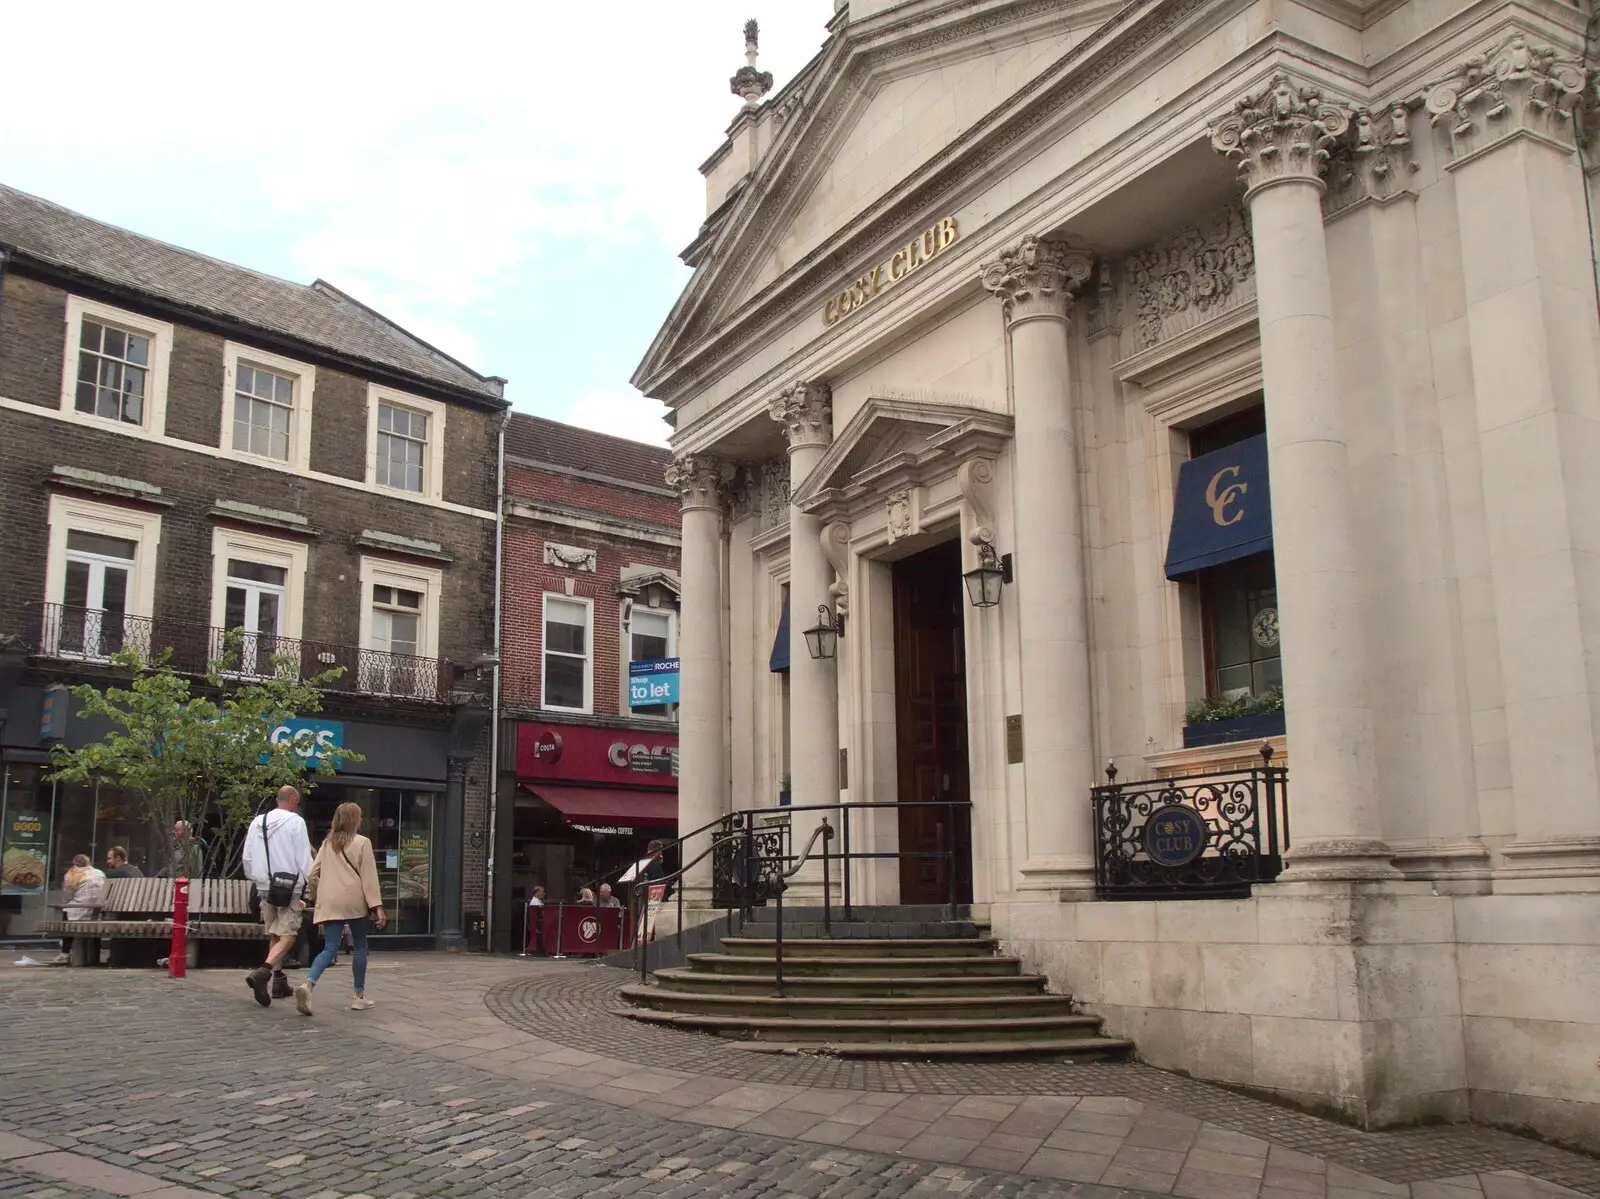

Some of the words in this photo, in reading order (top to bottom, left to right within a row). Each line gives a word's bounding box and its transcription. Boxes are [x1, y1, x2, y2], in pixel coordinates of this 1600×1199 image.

[822, 265, 884, 327] COSY
[887, 216, 958, 281] CLUB
[655, 661, 680, 669] ROCHE
[631, 685, 647, 698] to
[651, 683, 670, 697] let
[540, 744, 555, 752] COSTA
[1156, 836, 1193, 852] CLUB
